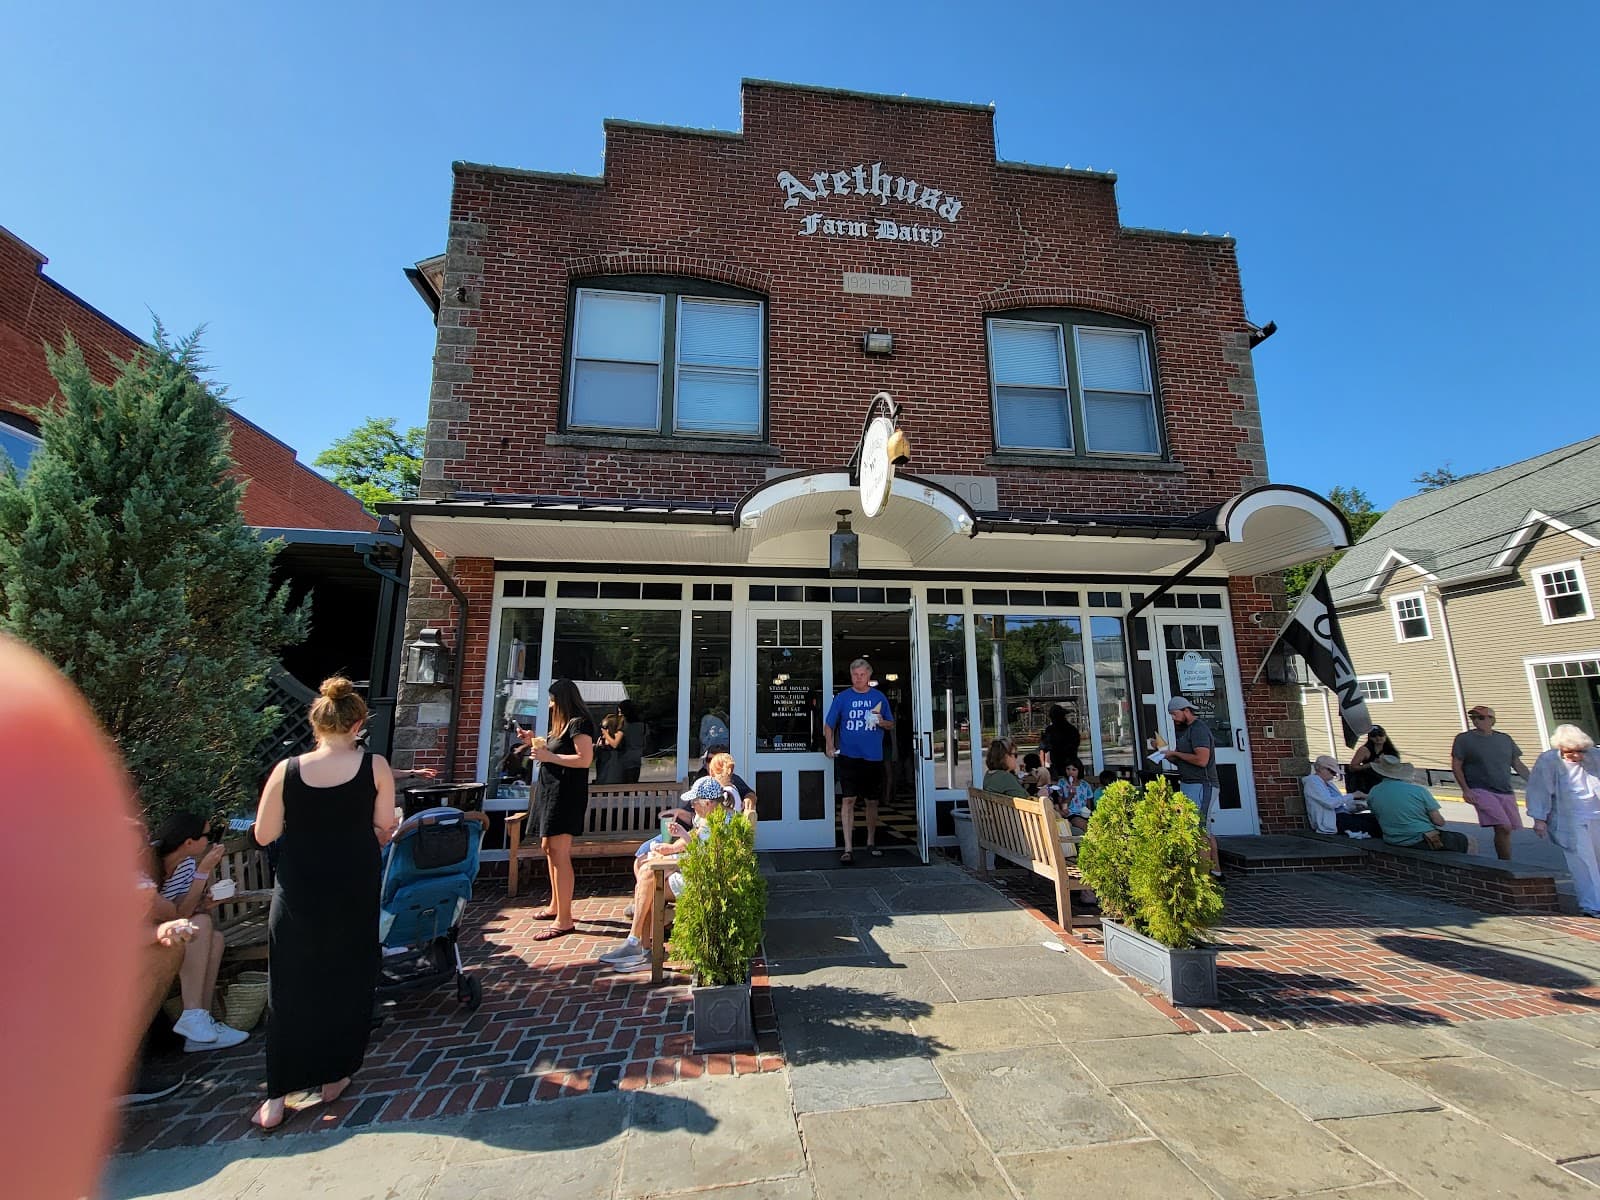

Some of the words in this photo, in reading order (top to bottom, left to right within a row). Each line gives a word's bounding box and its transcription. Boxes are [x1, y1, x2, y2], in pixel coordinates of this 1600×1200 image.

[776, 161, 963, 222] Arethusa
[798, 212, 869, 238] Farm
[874, 218, 943, 247] Dairy
[847, 276, 908, 293] 1921-1927
[1313, 613, 1365, 710] OEN
[852, 700, 872, 708] OPA!
